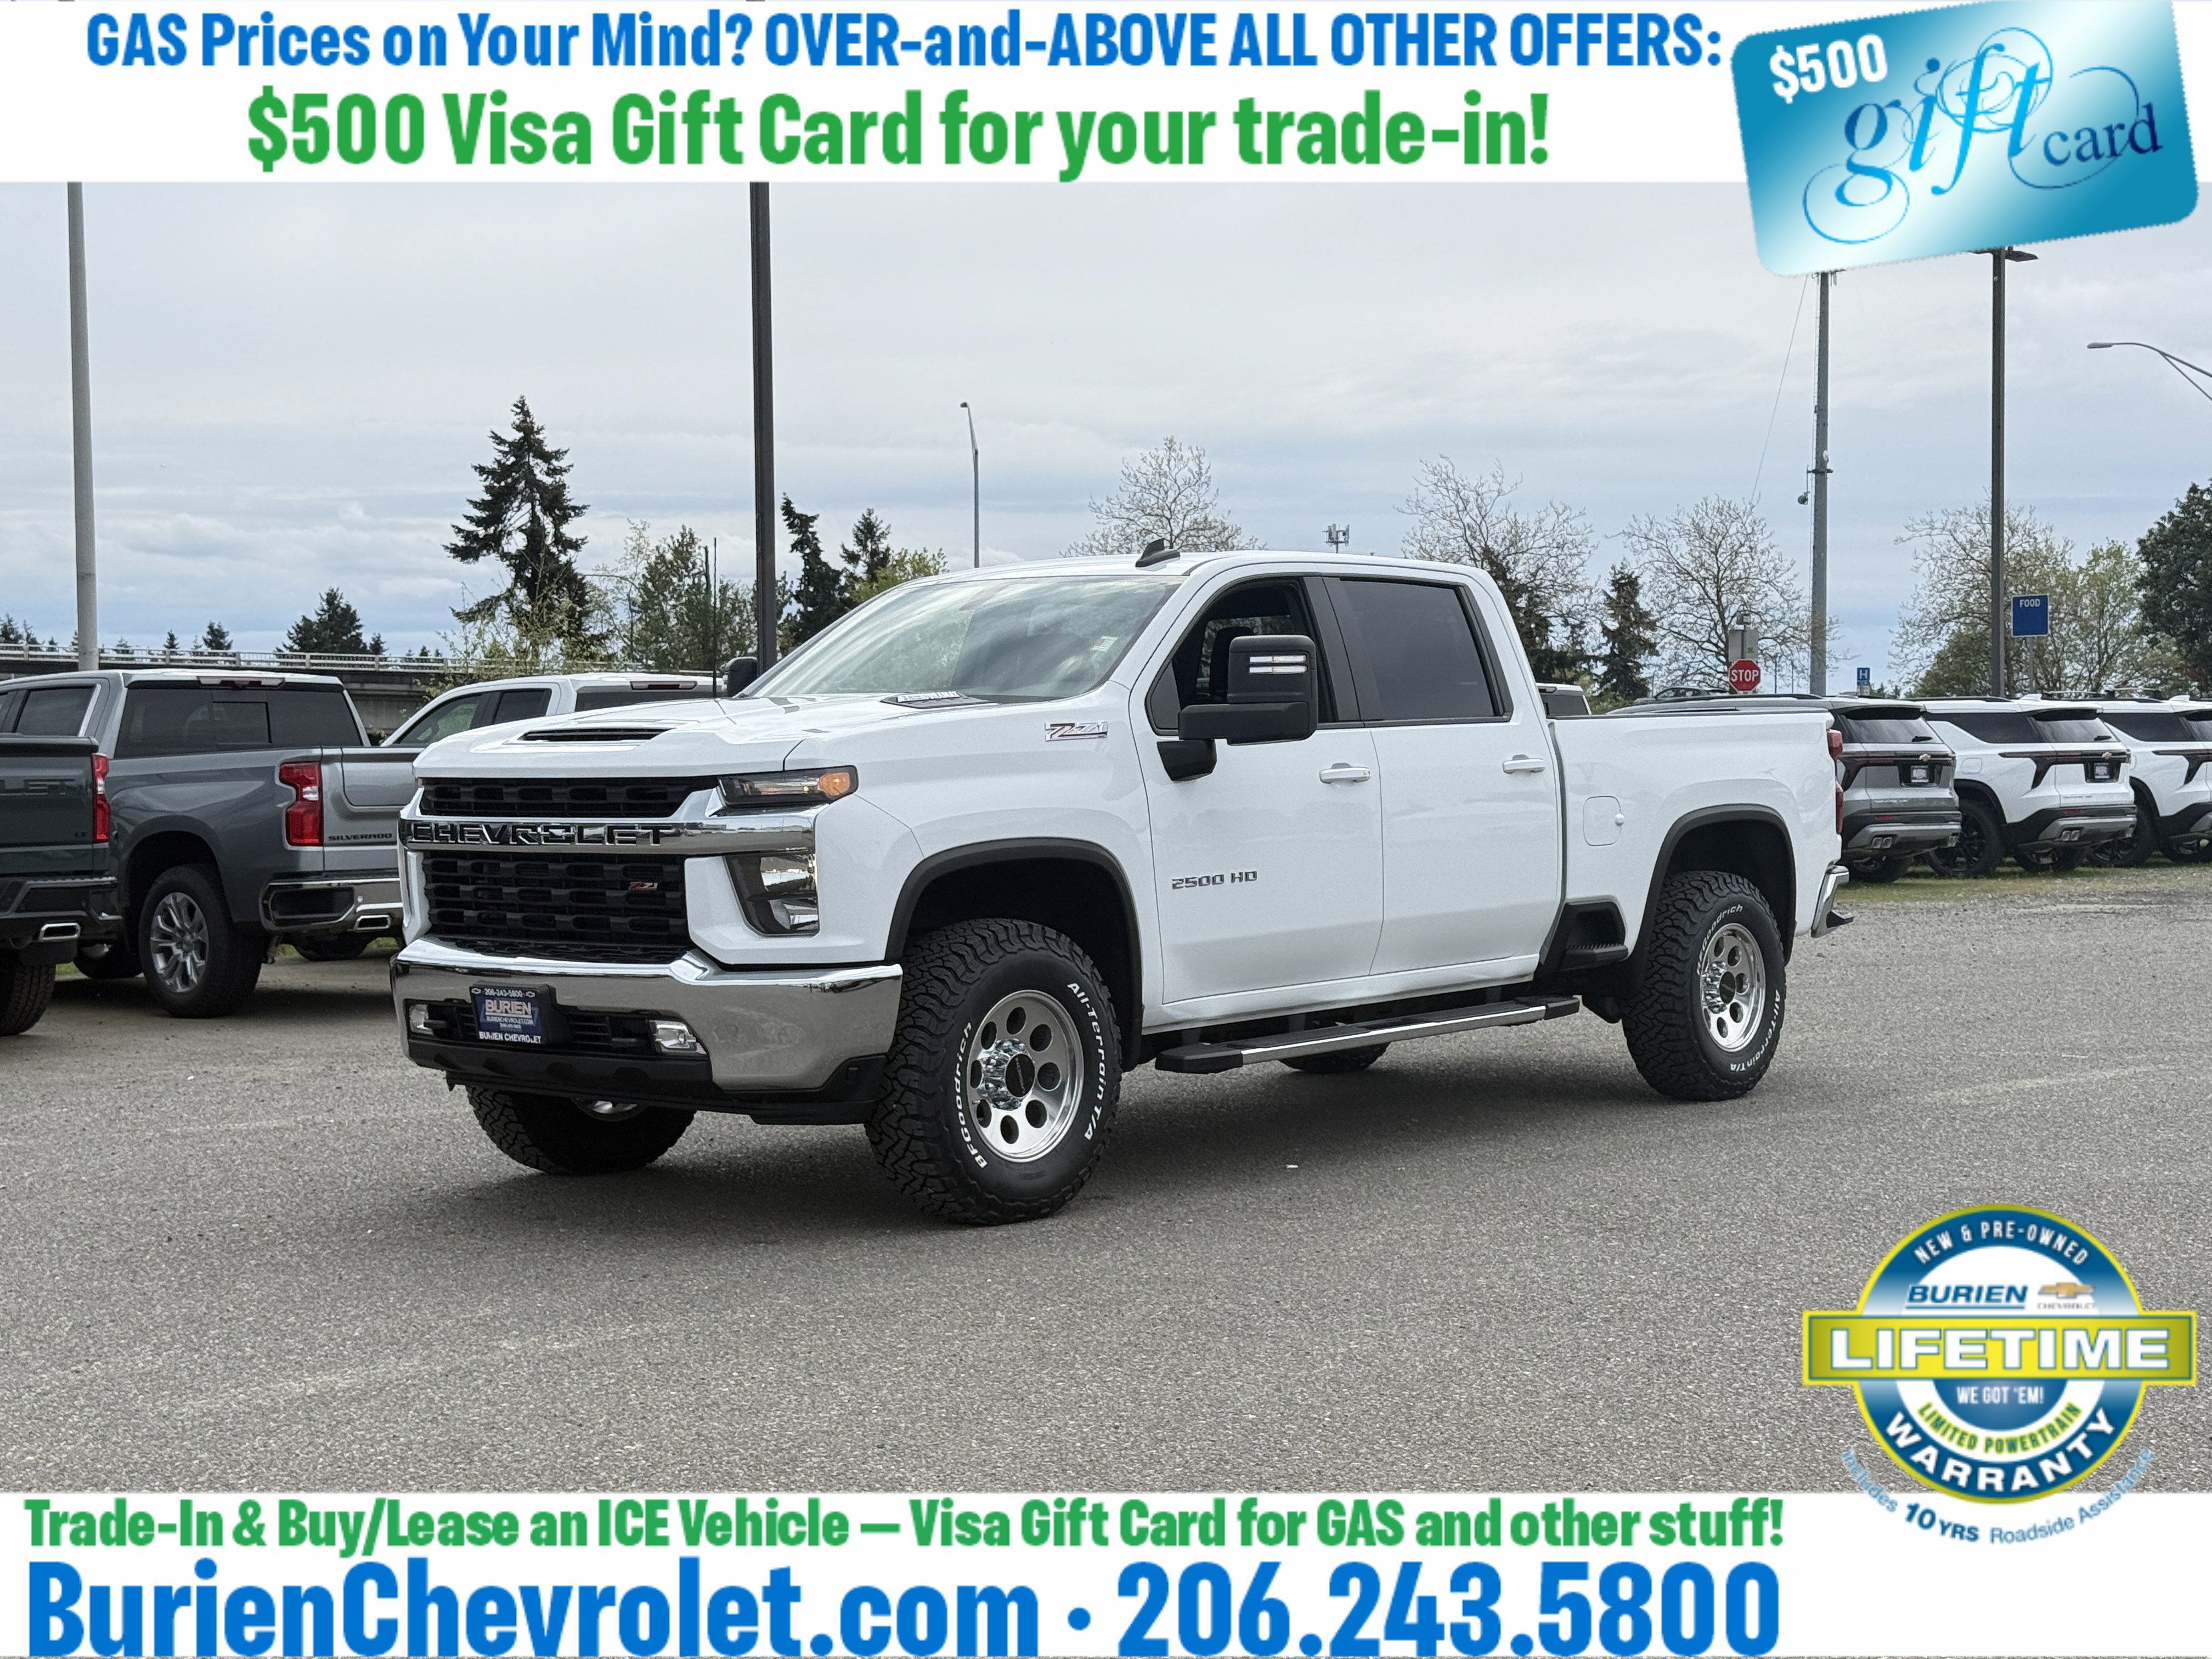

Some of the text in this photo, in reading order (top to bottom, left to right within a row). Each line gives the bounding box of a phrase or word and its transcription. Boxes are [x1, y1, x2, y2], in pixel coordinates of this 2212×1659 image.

[2019, 599, 2041, 608] FOOD
[1730, 669, 1759, 682] STOP
[1859, 669, 1868, 680] H
[408, 823, 674, 847] CHEVROLET
[1171, 871, 1257, 890] 2500 HD
[485, 999, 532, 1015] BURIEN
[479, 1031, 504, 1041] BURIEN
[1067, 983, 1107, 1141] All-Terrain T/A
[954, 1022, 988, 1169] BFGoodrich
